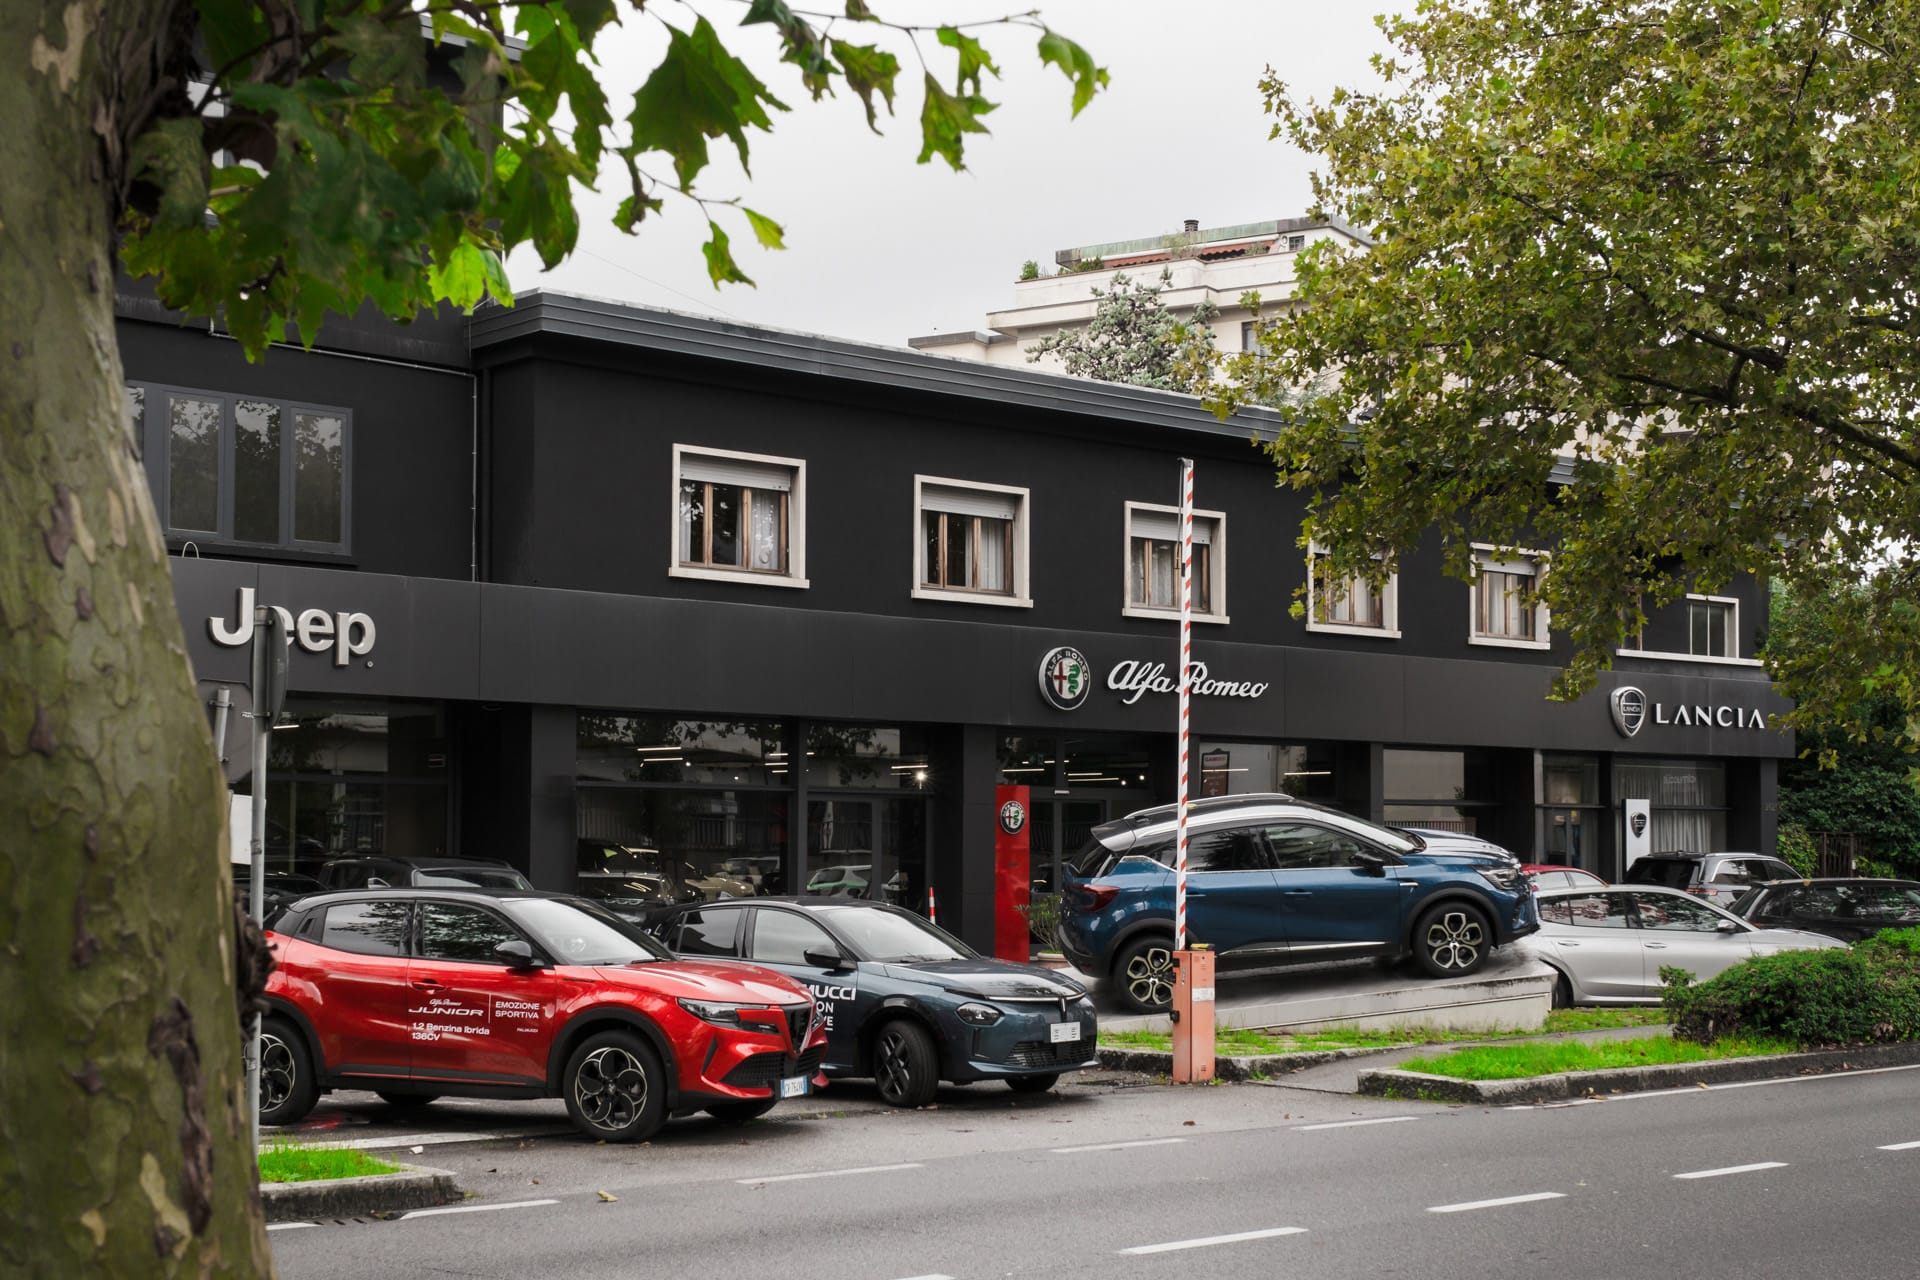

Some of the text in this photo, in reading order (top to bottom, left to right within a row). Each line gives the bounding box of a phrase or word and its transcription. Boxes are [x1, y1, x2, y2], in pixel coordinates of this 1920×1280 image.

[1047, 650, 1088, 681] ALFA ROMEO
[1107, 660, 1176, 704] Alfa
[1656, 703, 1765, 729] LANCIA
[408, 1006, 484, 1017] JUNIOR
[495, 1001, 540, 1010] EMOZIONE
[495, 1010, 539, 1019] SPORTIVA
[426, 1023, 462, 1033] Benzina
[464, 1025, 490, 1036] Ibrida
